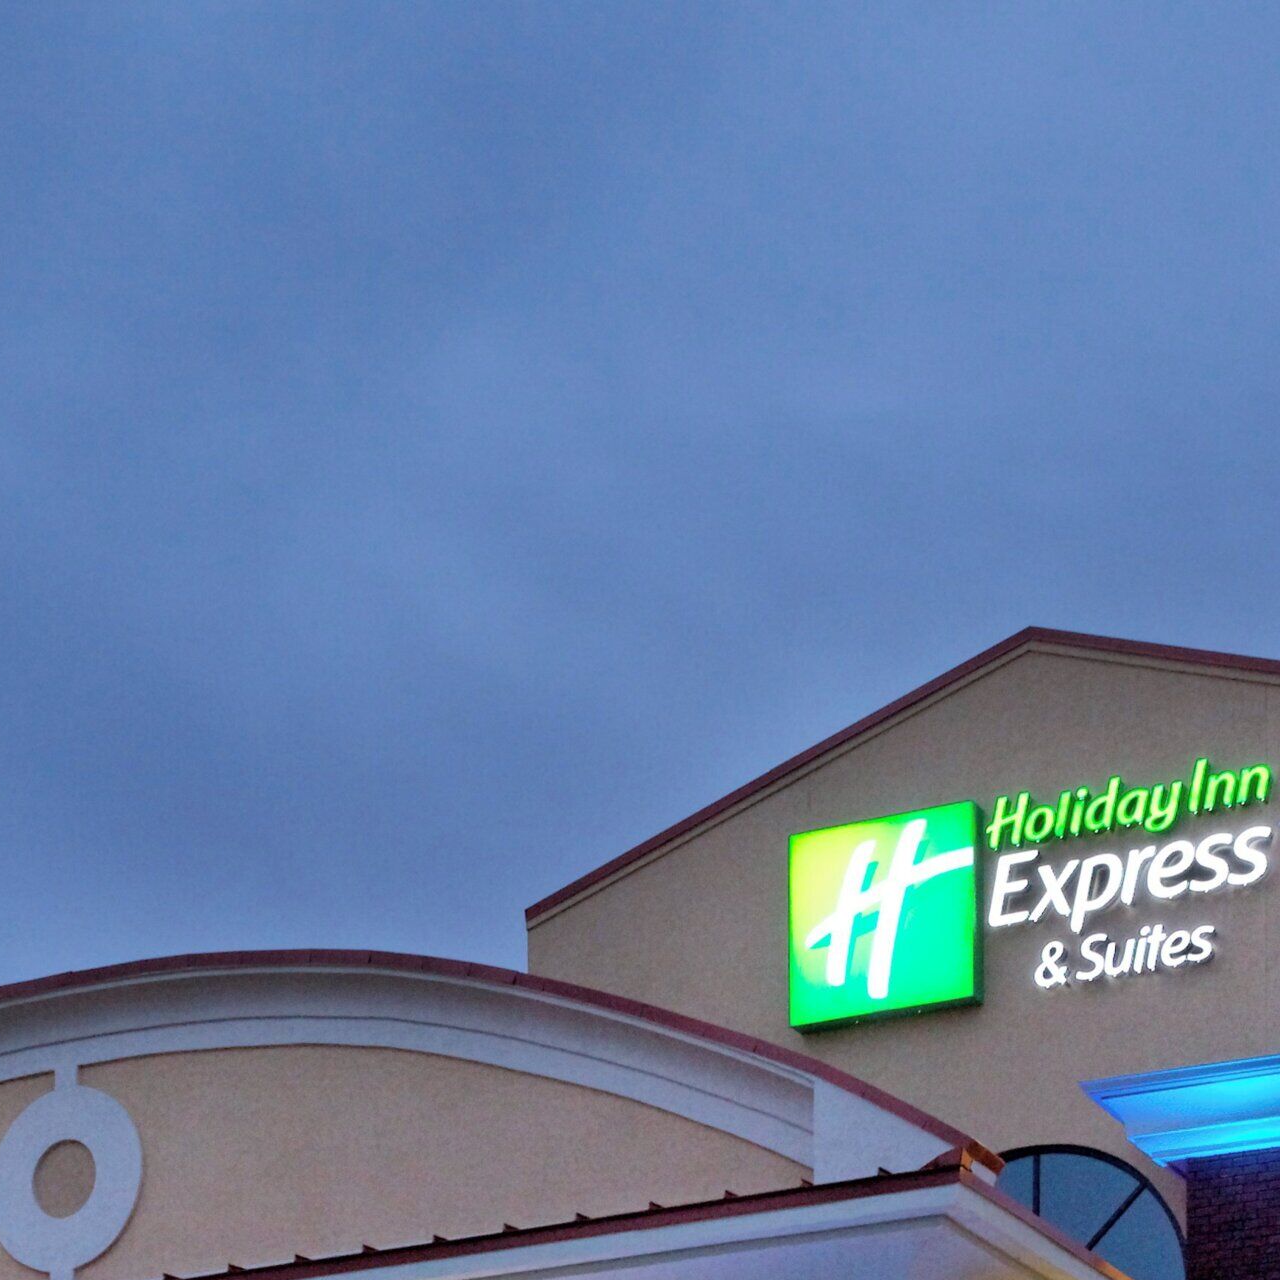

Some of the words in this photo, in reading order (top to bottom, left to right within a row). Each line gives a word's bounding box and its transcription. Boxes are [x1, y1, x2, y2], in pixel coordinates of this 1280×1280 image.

[986, 776, 1183, 850] Holiday
[1188, 758, 1272, 815] Inn
[988, 826, 1272, 934] Express
[1034, 940, 1068, 988] &
[1076, 924, 1216, 981] Suites
